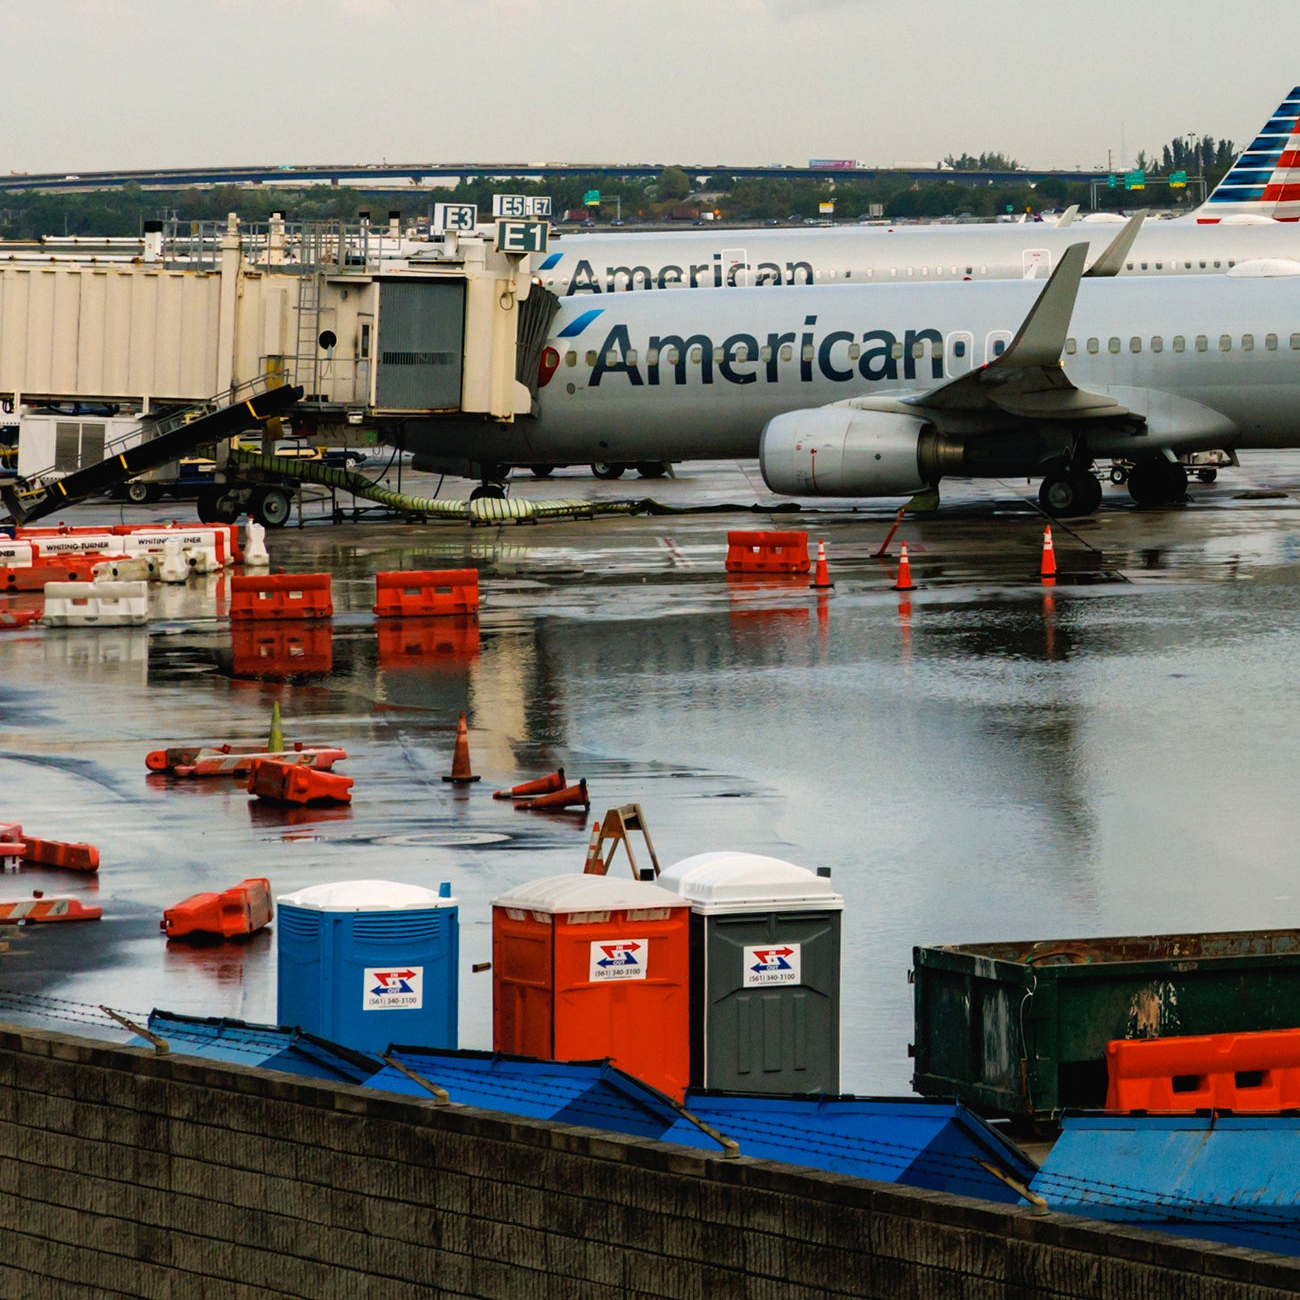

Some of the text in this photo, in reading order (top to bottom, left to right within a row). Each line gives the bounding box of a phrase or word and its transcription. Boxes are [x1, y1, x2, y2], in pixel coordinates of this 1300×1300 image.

[502, 196, 523, 215] E5
[534, 198, 549, 214] E7
[446, 207, 473, 230] E3
[503, 223, 541, 251] E1
[566, 253, 814, 296] American
[587, 315, 944, 387] American
[46, 541, 109, 551] WHITING-TURNER
